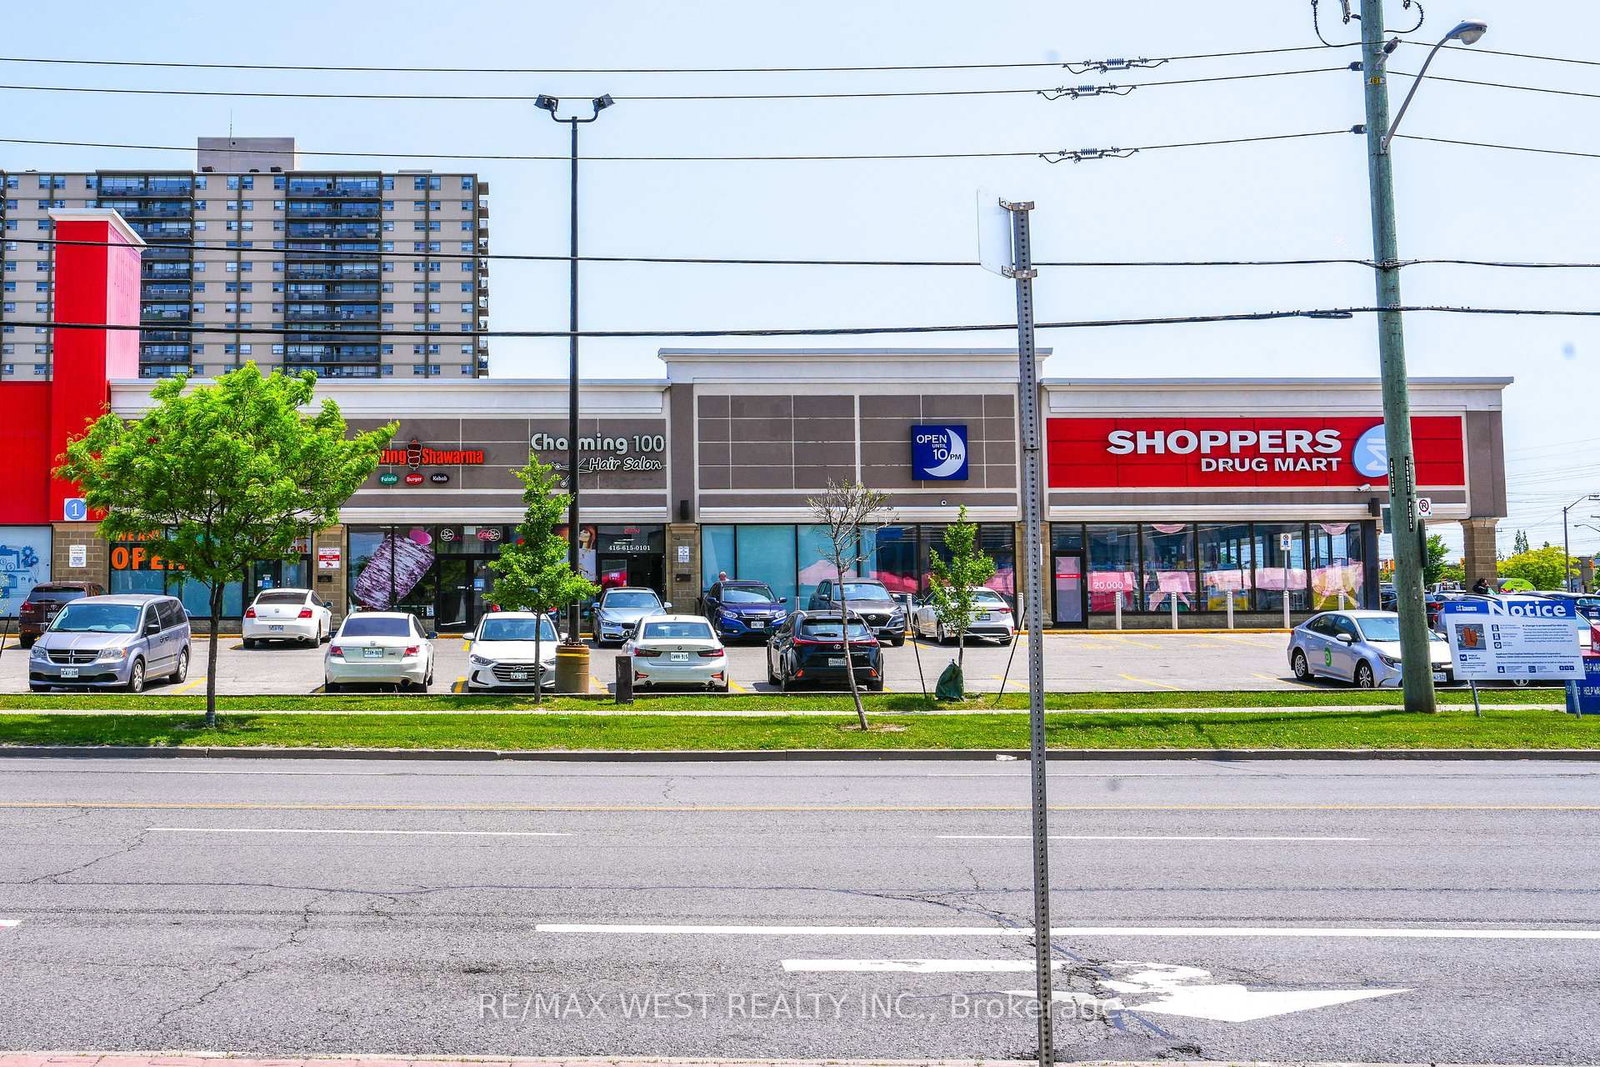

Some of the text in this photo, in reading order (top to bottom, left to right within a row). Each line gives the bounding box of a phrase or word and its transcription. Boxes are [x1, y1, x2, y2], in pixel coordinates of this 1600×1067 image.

[530, 432, 665, 455] Chaming 100
[916, 434, 948, 444] OPEN
[1106, 429, 1343, 455] SHOPPERS
[422, 447, 484, 464] Shawarma
[932, 448, 962, 461] 10 PM
[588, 455, 663, 471] Hair Salon
[1200, 457, 1342, 472] DRUG MART
[71, 502, 80, 517] 1
[1093, 580, 1124, 590] 20,000
[1487, 600, 1566, 618] Notice
